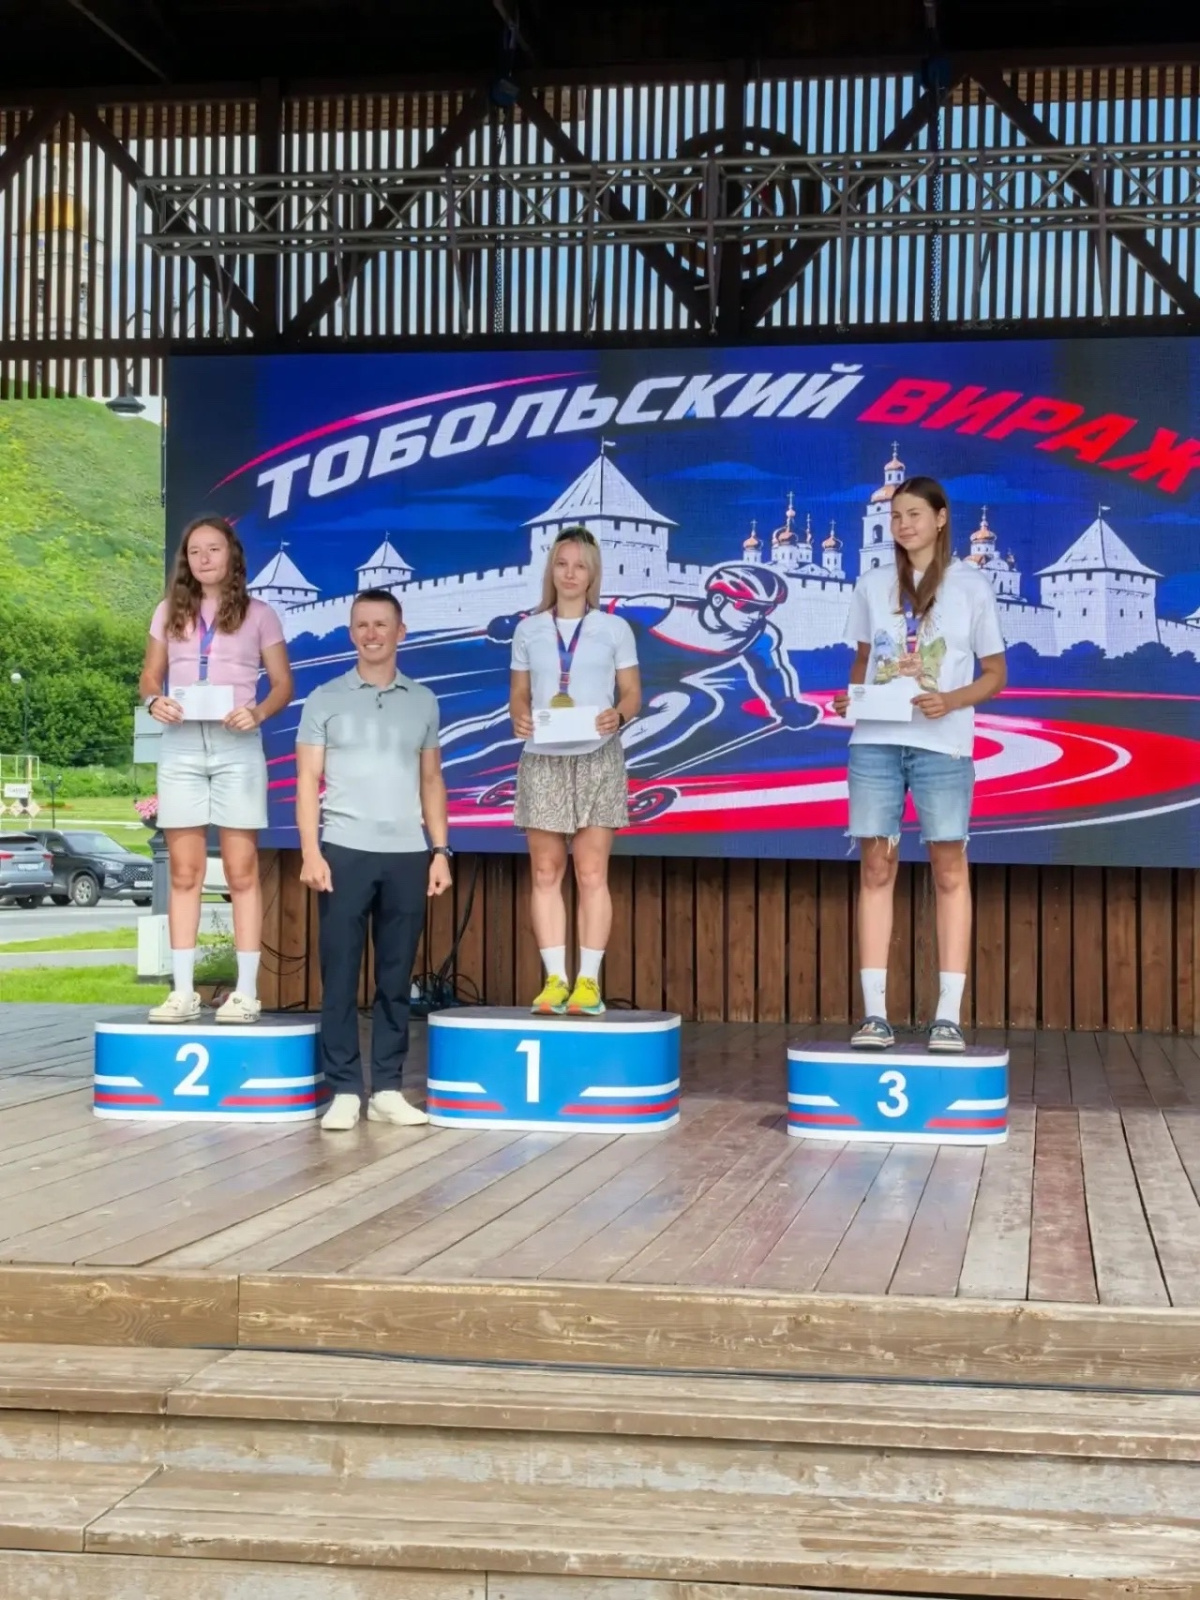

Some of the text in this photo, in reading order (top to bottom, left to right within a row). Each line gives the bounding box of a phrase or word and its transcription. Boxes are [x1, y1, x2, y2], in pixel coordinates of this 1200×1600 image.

[257, 363, 1200, 519] ТОБОЛЬСКИЙ ВИРАЖ
[172, 1042, 210, 1097] 2
[514, 1039, 541, 1103] 1
[876, 1070, 909, 1118] 3
